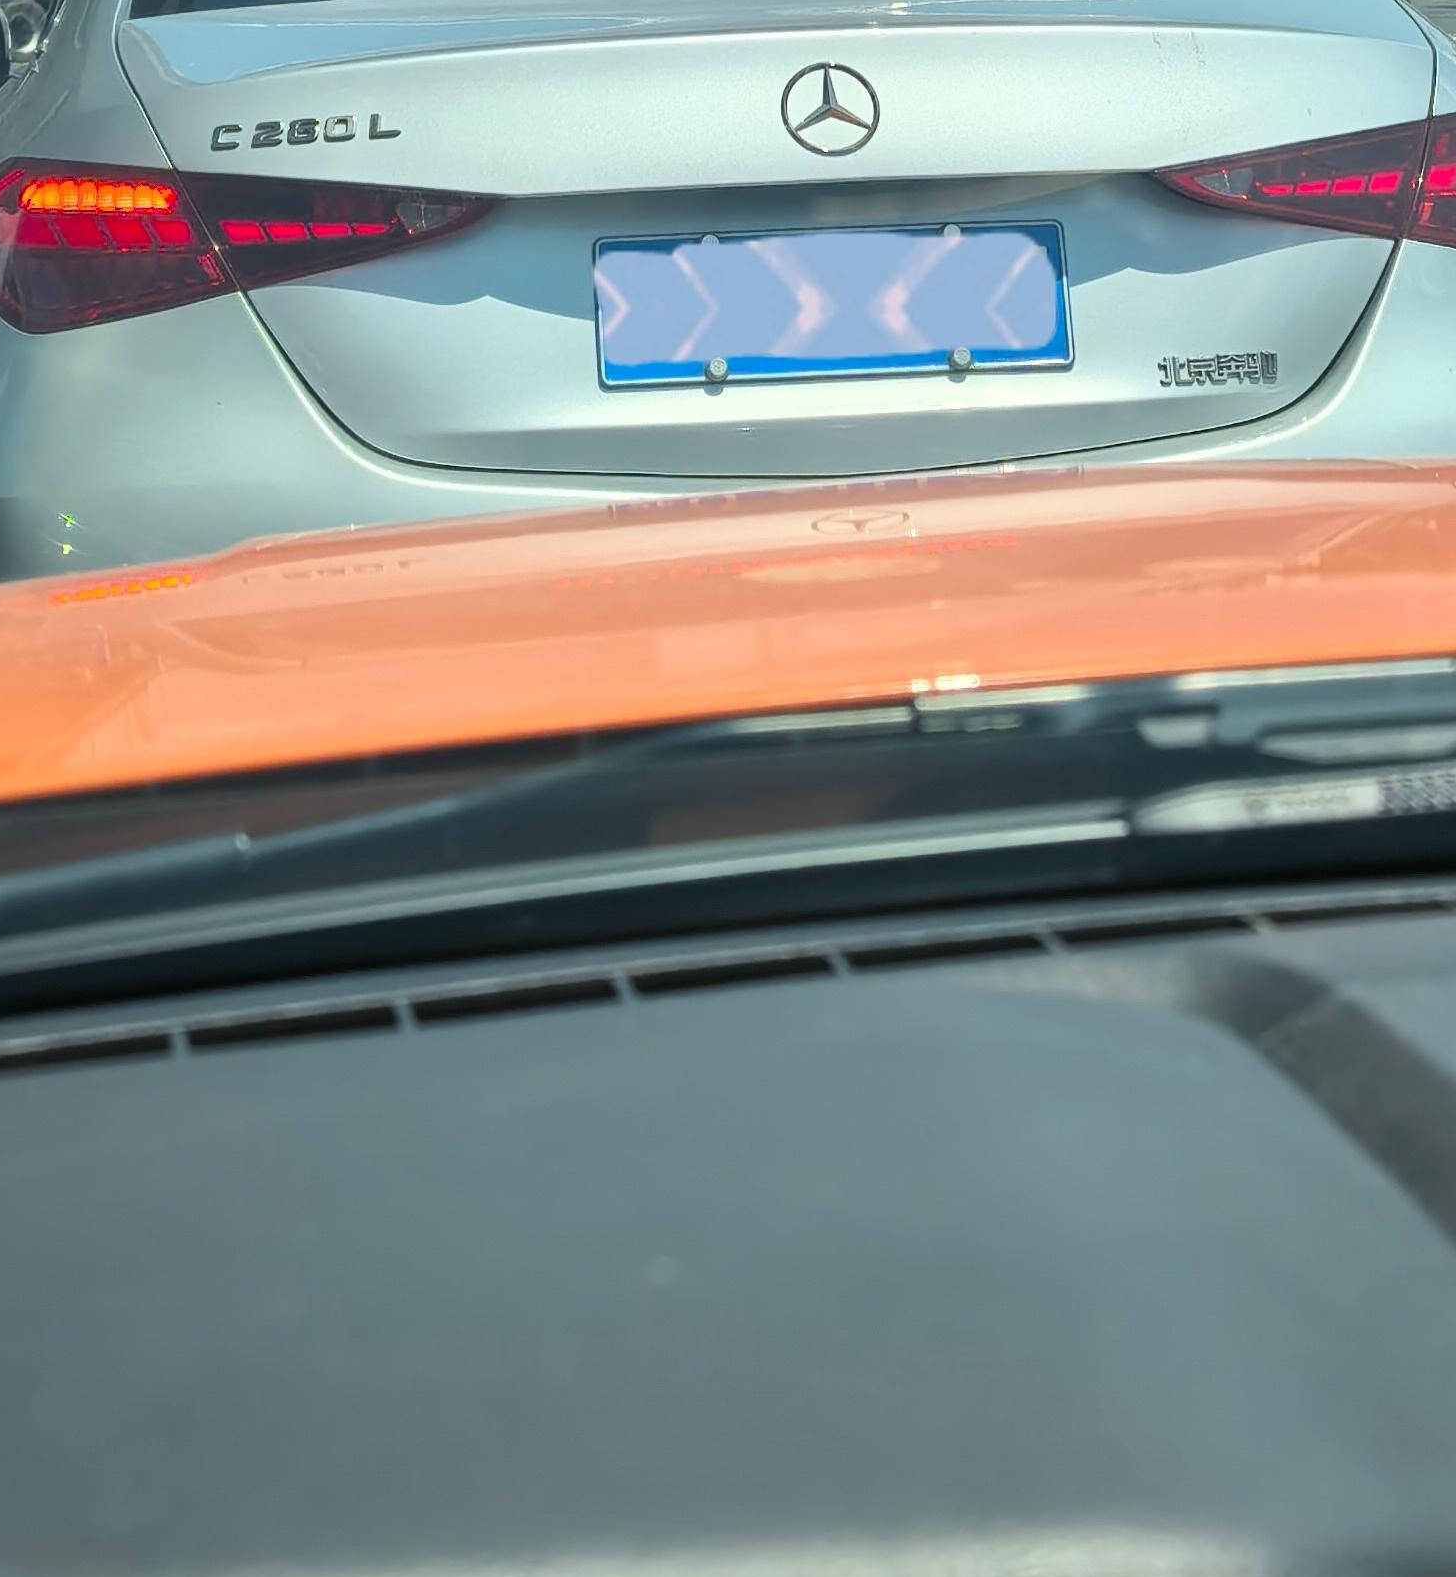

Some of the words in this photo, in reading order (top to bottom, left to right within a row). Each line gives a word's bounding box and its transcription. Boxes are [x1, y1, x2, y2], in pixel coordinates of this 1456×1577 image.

[211, 124, 243, 152] C
[251, 114, 358, 149] 260
[369, 113, 402, 140] L
[1157, 349, 1279, 387] 北京奔驰
